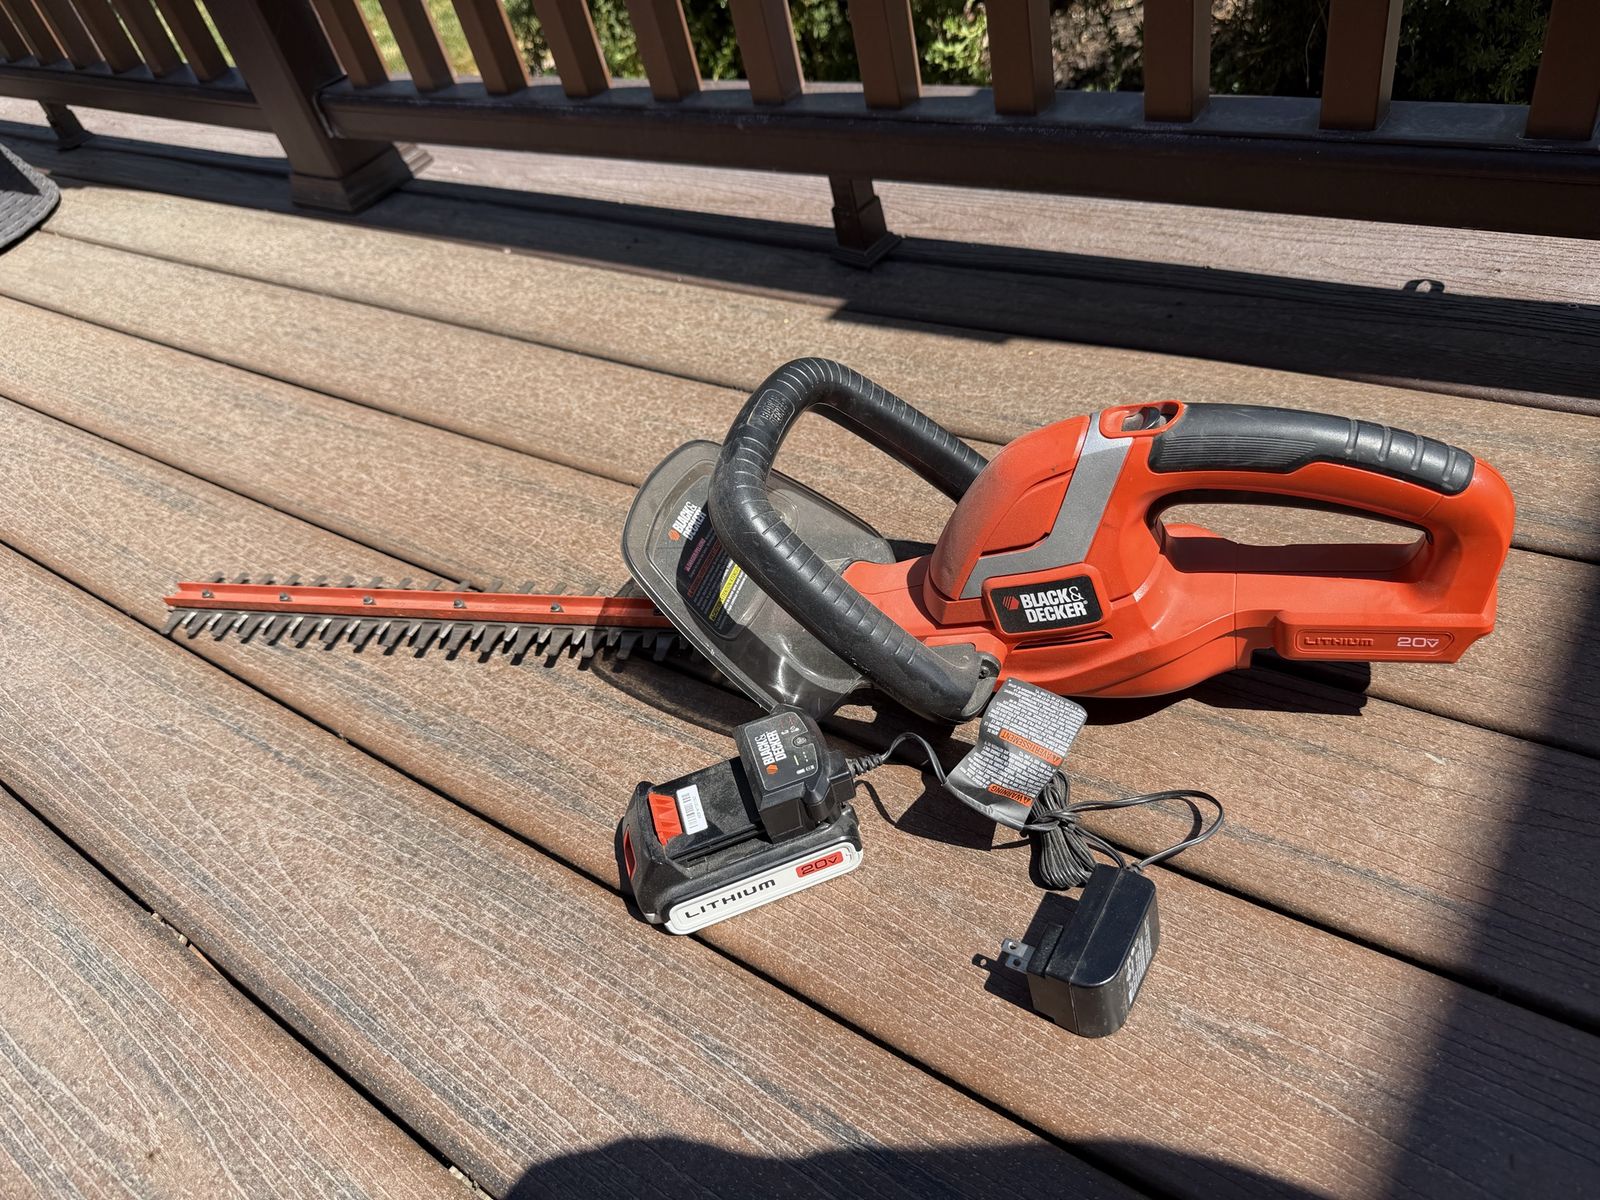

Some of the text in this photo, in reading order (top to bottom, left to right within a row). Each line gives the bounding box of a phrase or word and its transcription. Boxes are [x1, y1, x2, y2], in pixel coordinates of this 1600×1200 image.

[682, 508, 706, 540] DECKER
[1304, 636, 1374, 647] LITHIUM
[766, 730, 787, 761] DECKER
[1001, 732, 1052, 759] AVERTISSEMENT
[990, 785, 1024, 803] WARNING
[685, 879, 776, 919] LITHIUM
